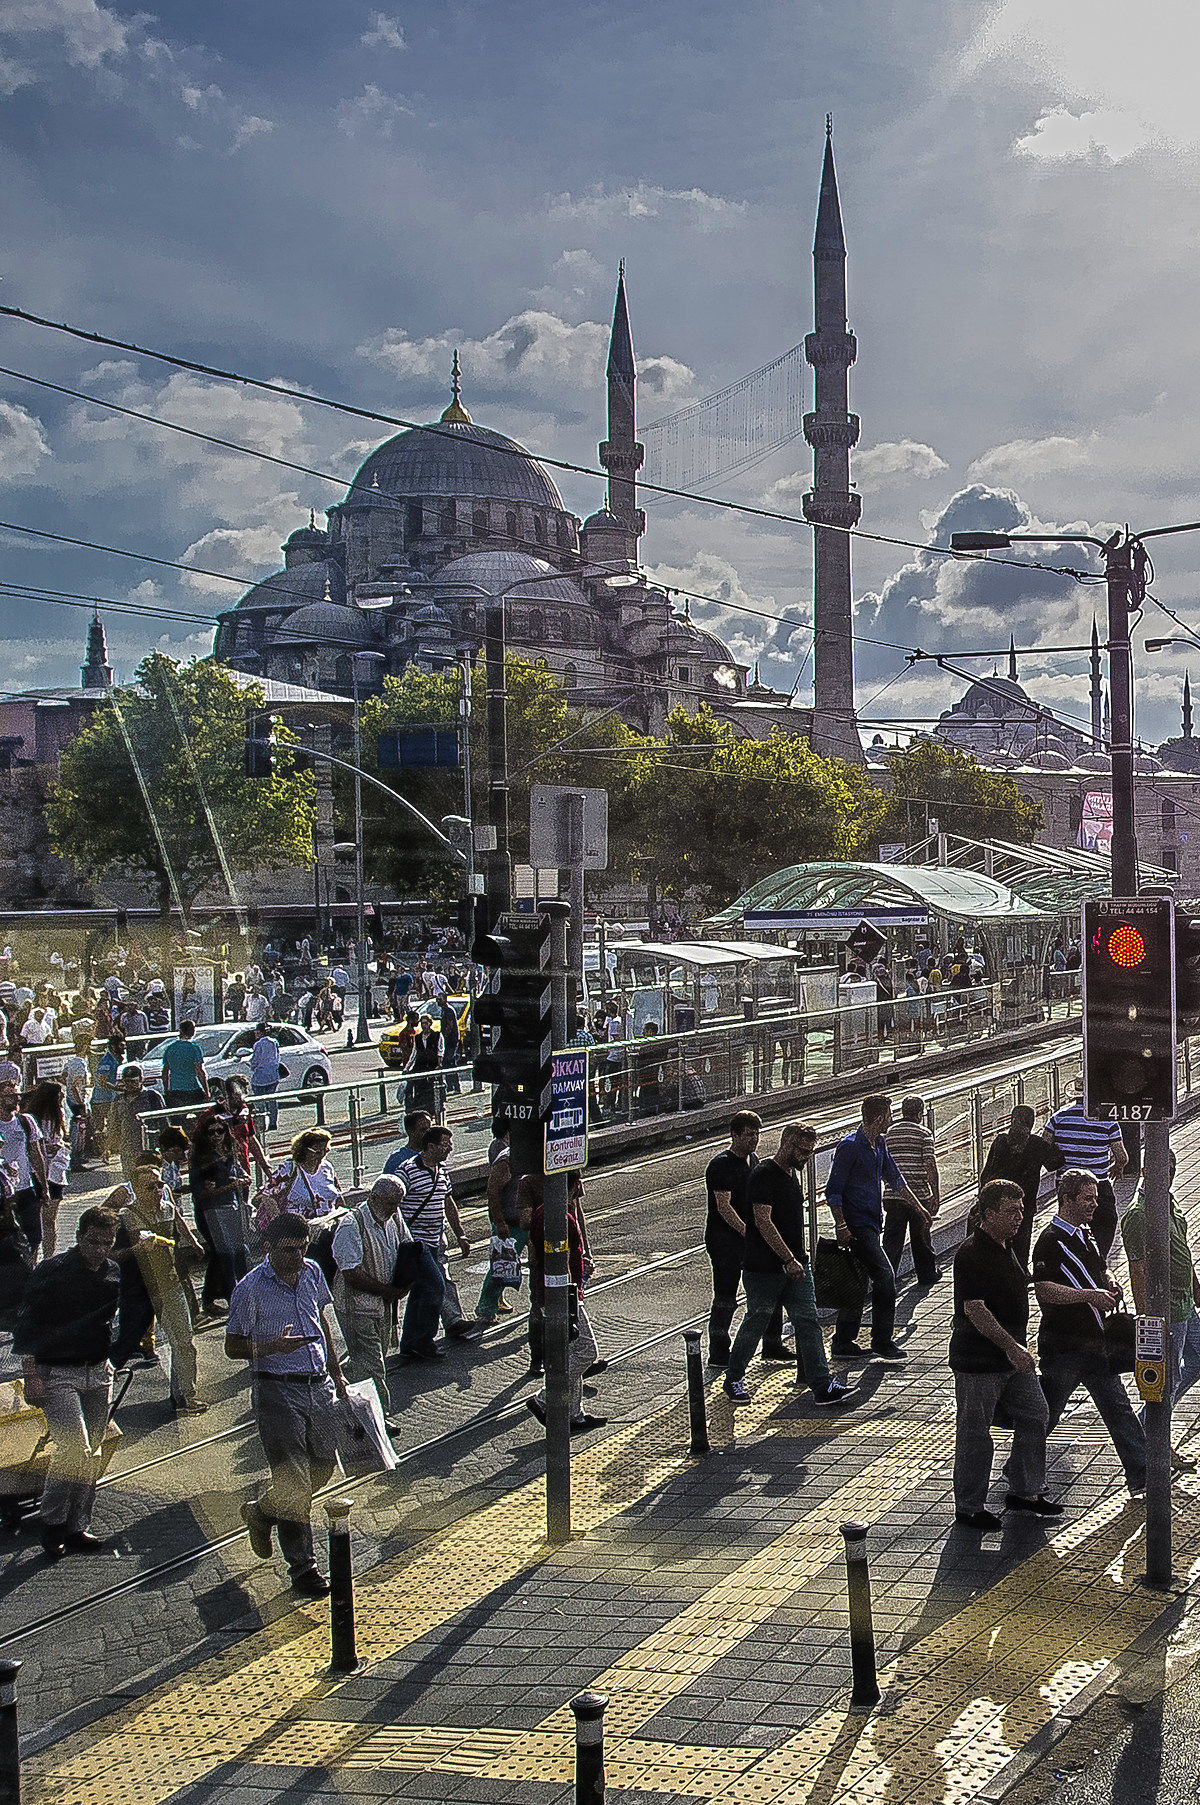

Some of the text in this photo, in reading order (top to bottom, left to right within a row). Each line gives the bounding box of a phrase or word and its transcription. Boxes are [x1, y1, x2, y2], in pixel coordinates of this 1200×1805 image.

[551, 1079, 586, 1095] RAMVAY
[504, 1104, 533, 1120] 4187
[1108, 1105, 1153, 1120] 4187
